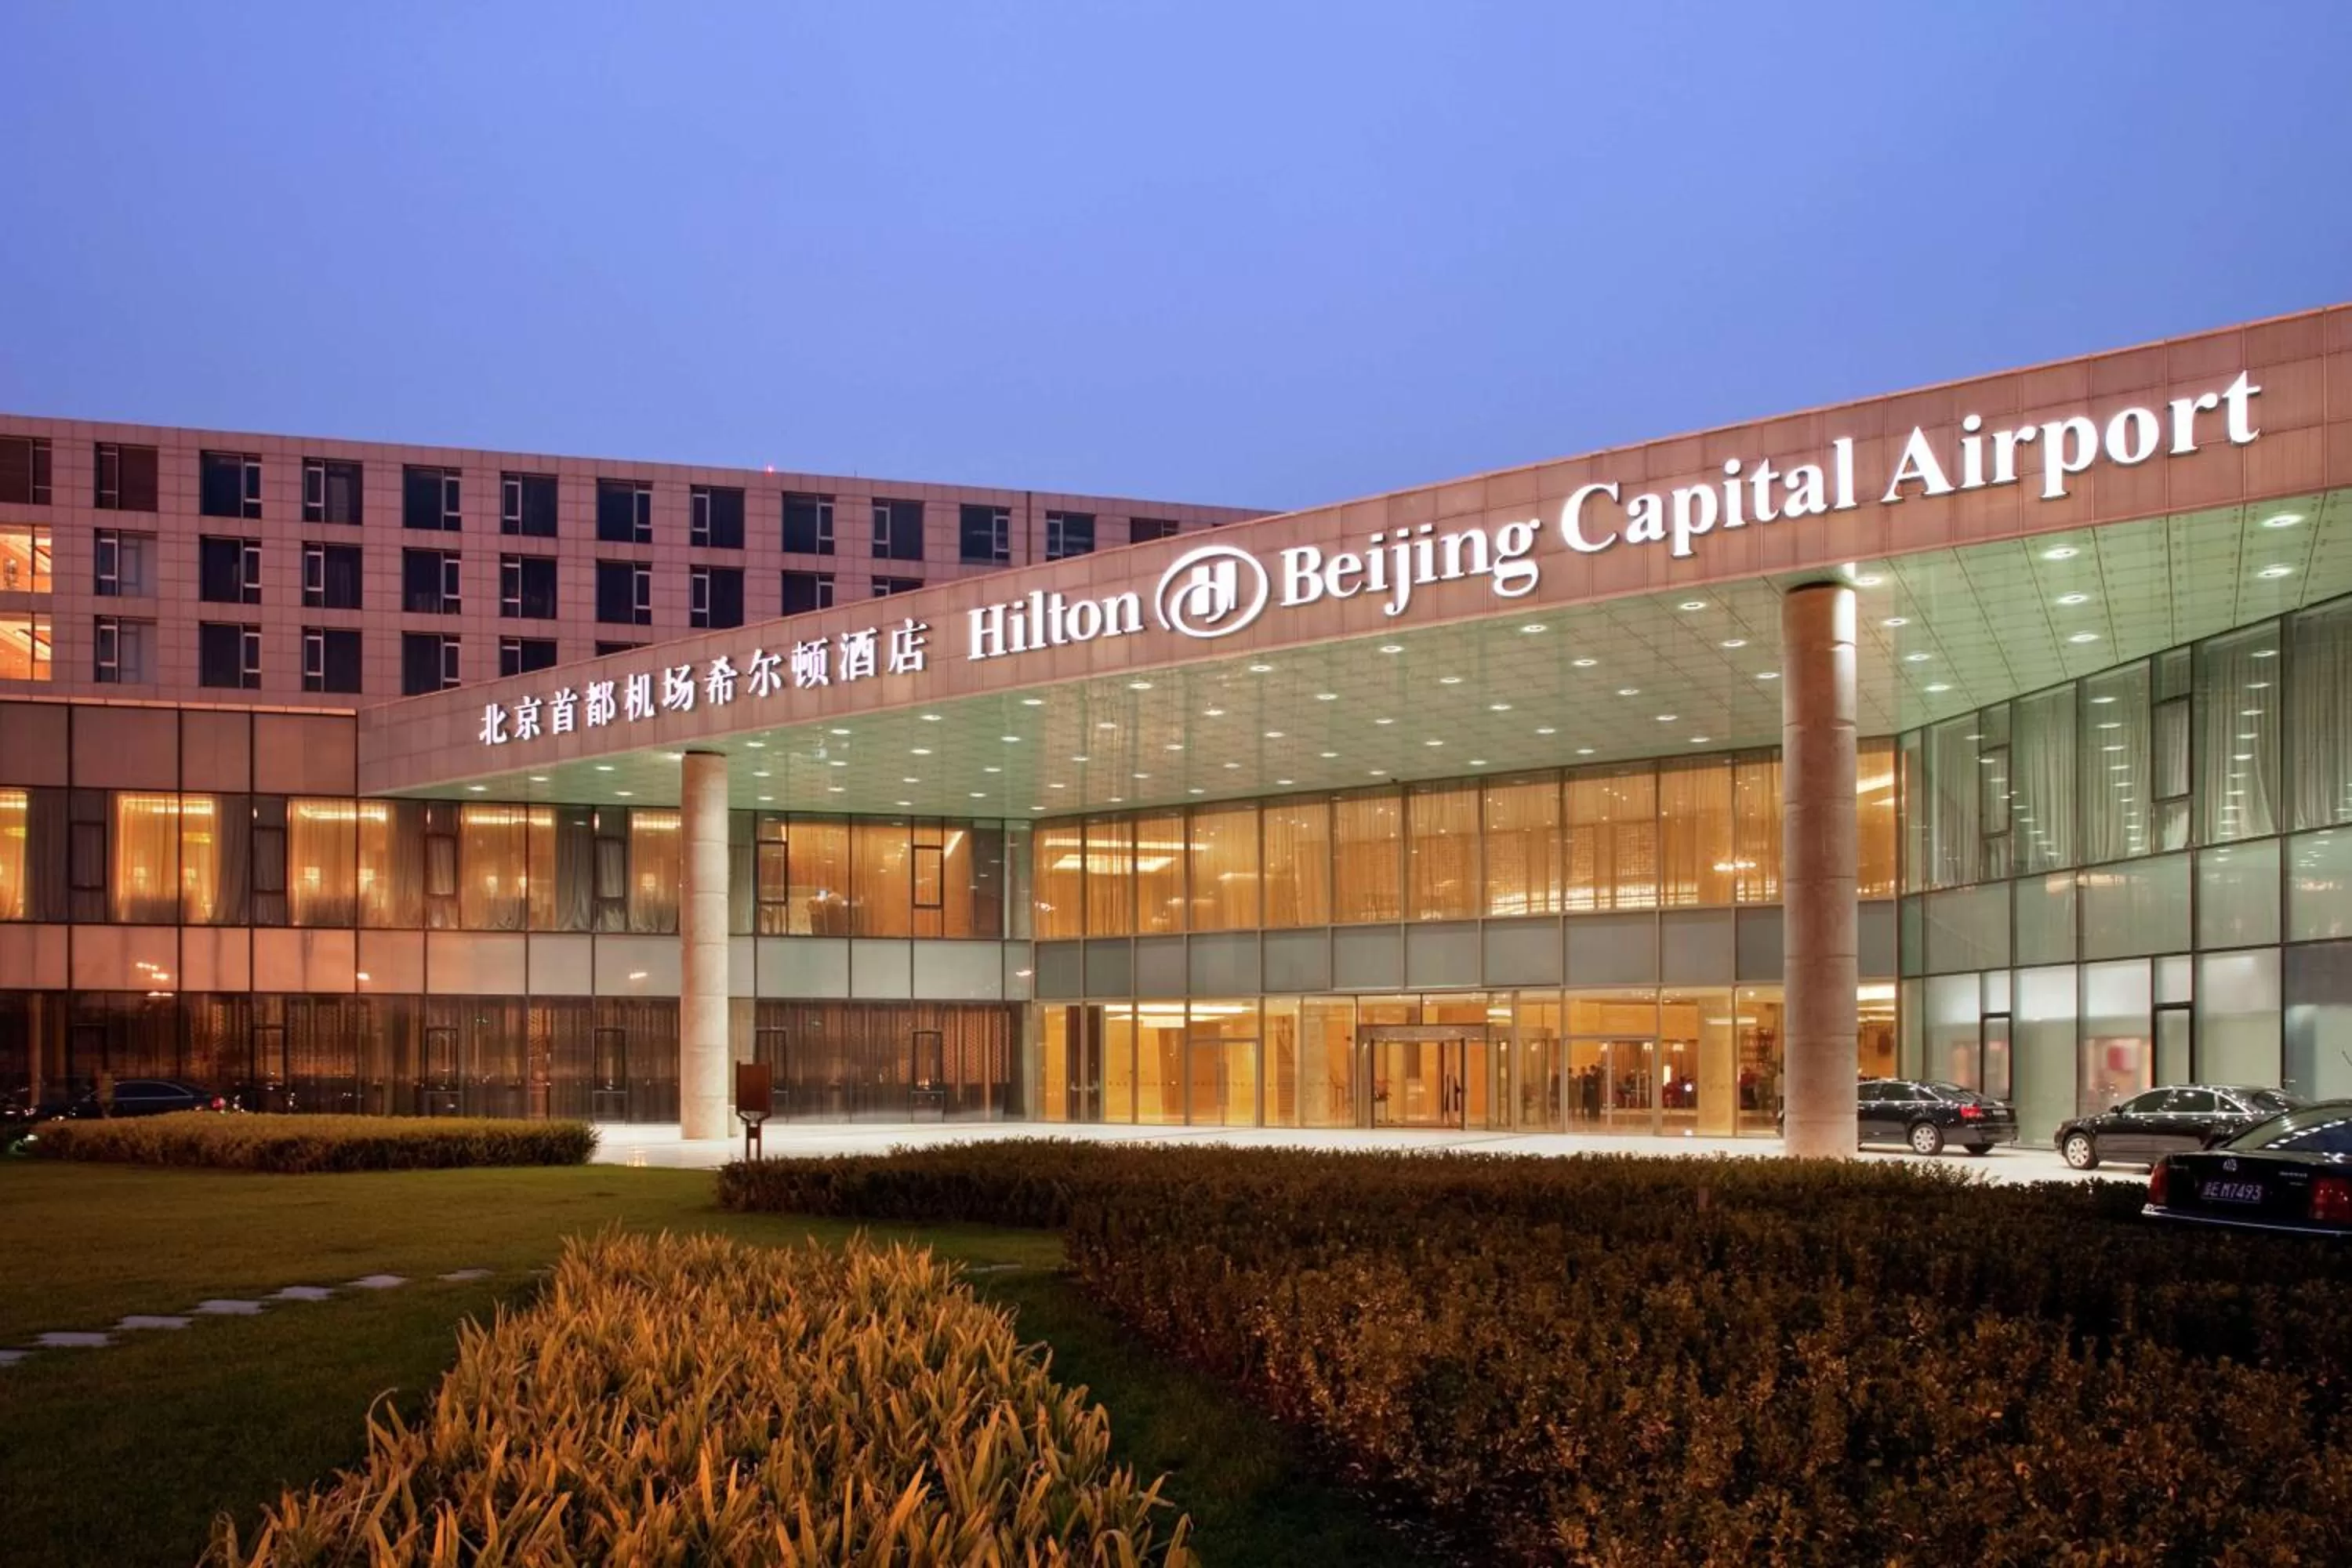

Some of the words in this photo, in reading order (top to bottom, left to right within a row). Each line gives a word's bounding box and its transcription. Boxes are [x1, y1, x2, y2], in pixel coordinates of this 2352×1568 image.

[967, 587, 1144, 661] Hilton
[1279, 517, 1541, 616] Beijing
[1559, 436, 1857, 558] Capital
[1882, 370, 2262, 503] Airport
[479, 617, 928, 746] 北京首都机场希尔顿酒店
